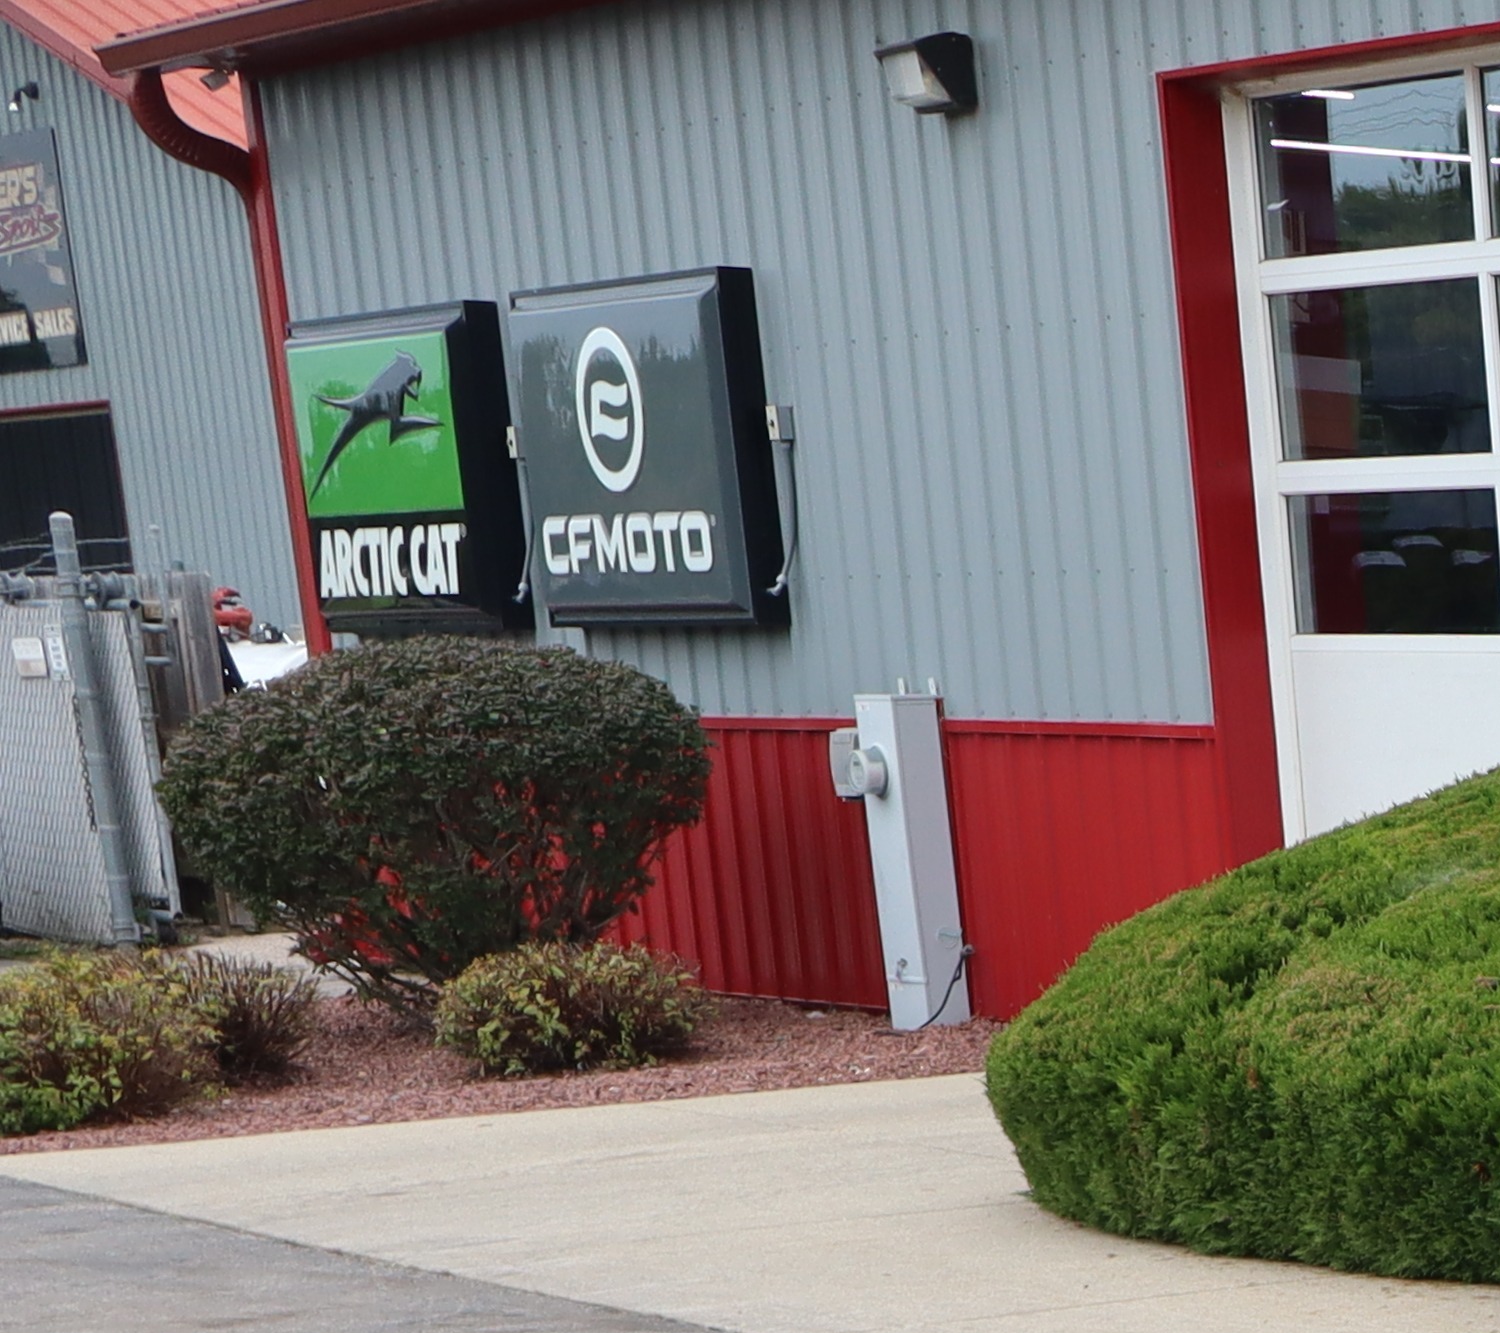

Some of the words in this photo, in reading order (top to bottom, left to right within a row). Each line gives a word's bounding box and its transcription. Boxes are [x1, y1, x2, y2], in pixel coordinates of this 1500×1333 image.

[34, 307, 77, 341] SALES
[319, 526, 407, 599] ARCTIC
[409, 523, 463, 596] CAT
[542, 510, 714, 575] CFMOTO
